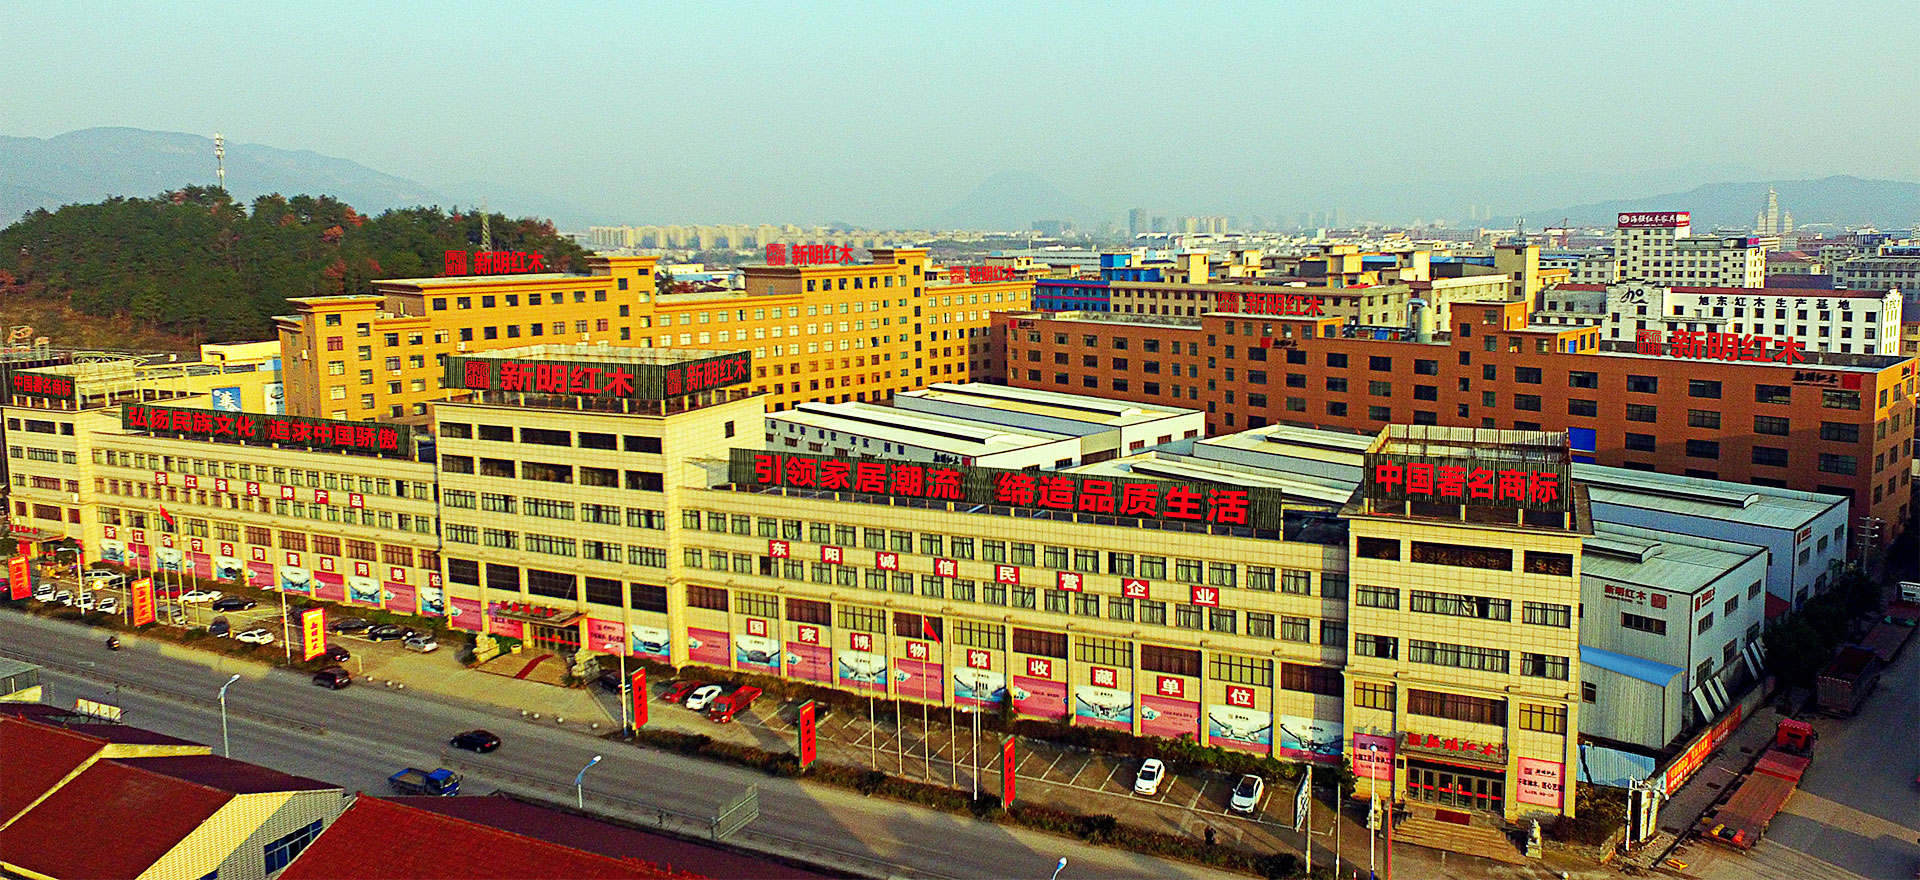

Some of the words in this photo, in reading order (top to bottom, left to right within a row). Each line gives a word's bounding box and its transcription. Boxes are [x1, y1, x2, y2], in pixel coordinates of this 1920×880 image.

[474, 250, 545, 275] 新明红木
[791, 243, 854, 266] 新明红木
[969, 264, 1017, 283] 新明红木
[1245, 291, 1324, 317] 新明红木
[1698, 295, 1851, 311] 旭东红木生产基地
[1670, 328, 1806, 366] 新明红木
[13, 373, 72, 397] 中国著名商标
[500, 361, 635, 398] 新明红木
[686, 356, 747, 392] 新明红木
[128, 406, 256, 437] 弘扬民族文化
[269, 418, 399, 450] 追求中国骄傲
[754, 454, 962, 500] 引领家居潮流
[997, 471, 1249, 525] 缔造品质生活
[1375, 459, 1558, 503] 中国著名商标
[771, 542, 1216, 605] 东阳诚信民营企业
[750, 620, 1252, 705] 国家博物馆收藏单位
